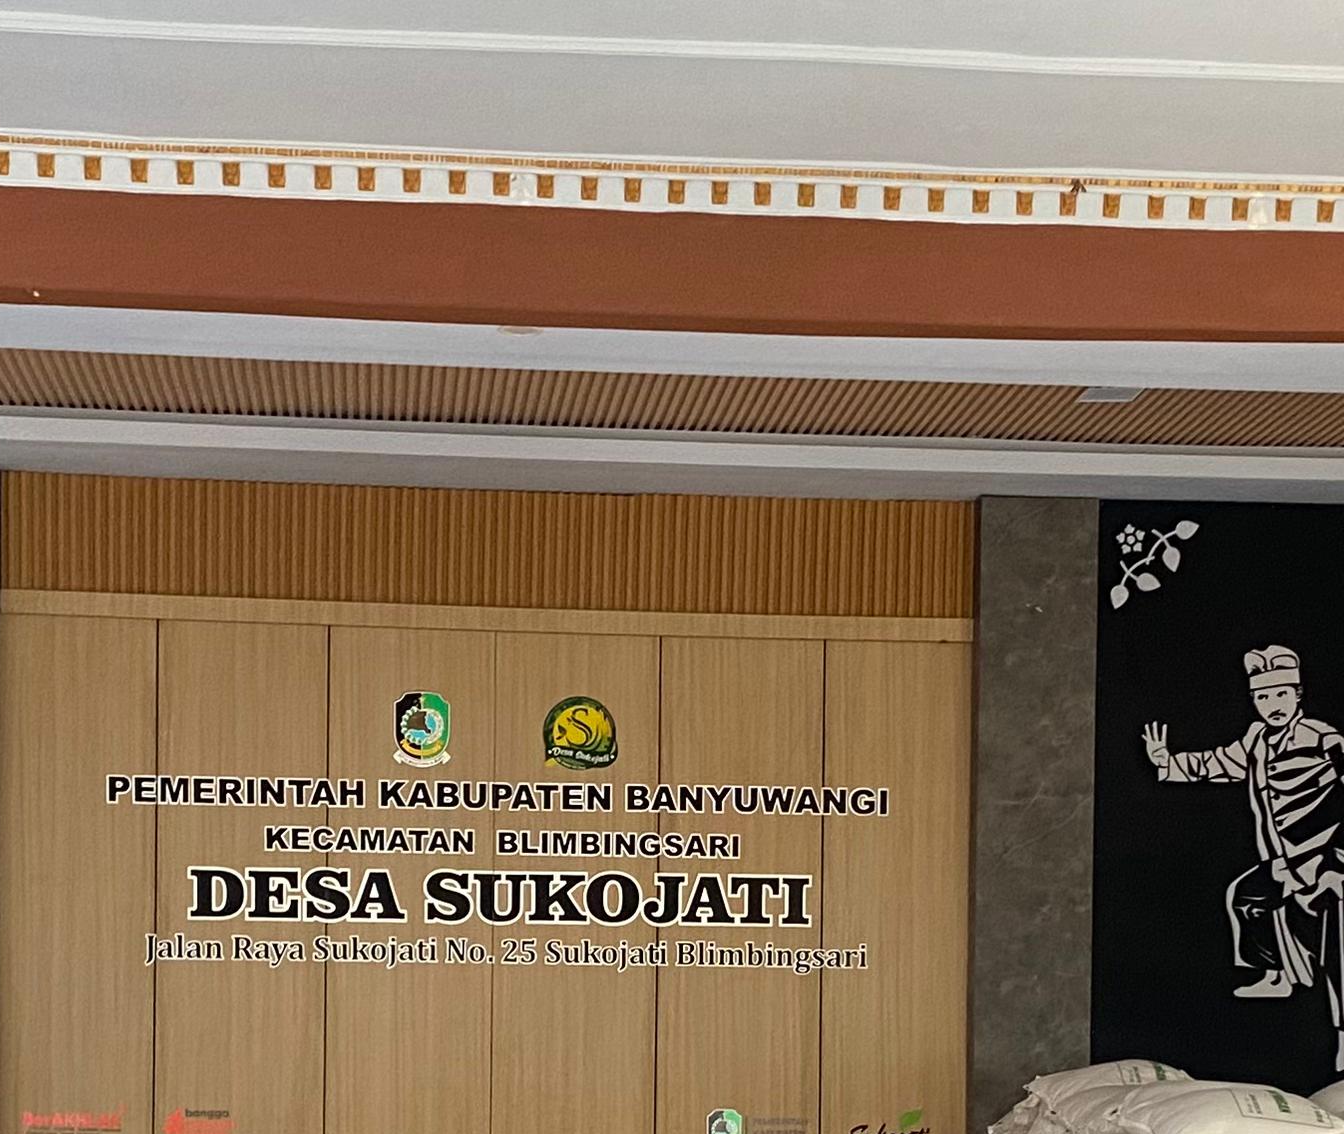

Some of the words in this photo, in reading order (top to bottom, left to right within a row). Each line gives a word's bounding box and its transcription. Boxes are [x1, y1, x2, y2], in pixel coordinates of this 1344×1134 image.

[107, 775, 366, 808] PEMERINTAH
[378, 779, 612, 812] KABUPATEN
[624, 783, 889, 816] BANYUWANGI
[264, 827, 475, 854] KECAMATAN
[497, 830, 741, 859] BLIMBINGSARI
[187, 865, 407, 923] DESA
[424, 869, 812, 927] SUKOJATI
[144, 934, 222, 964] Jalan
[232, 935, 305, 967] Raya
[313, 935, 436, 968] Sukojati
[444, 938, 494, 964] No.
[502, 938, 537, 965] 25
[544, 939, 667, 972] Sukojati
[675, 941, 868, 974] Blimbingsari
